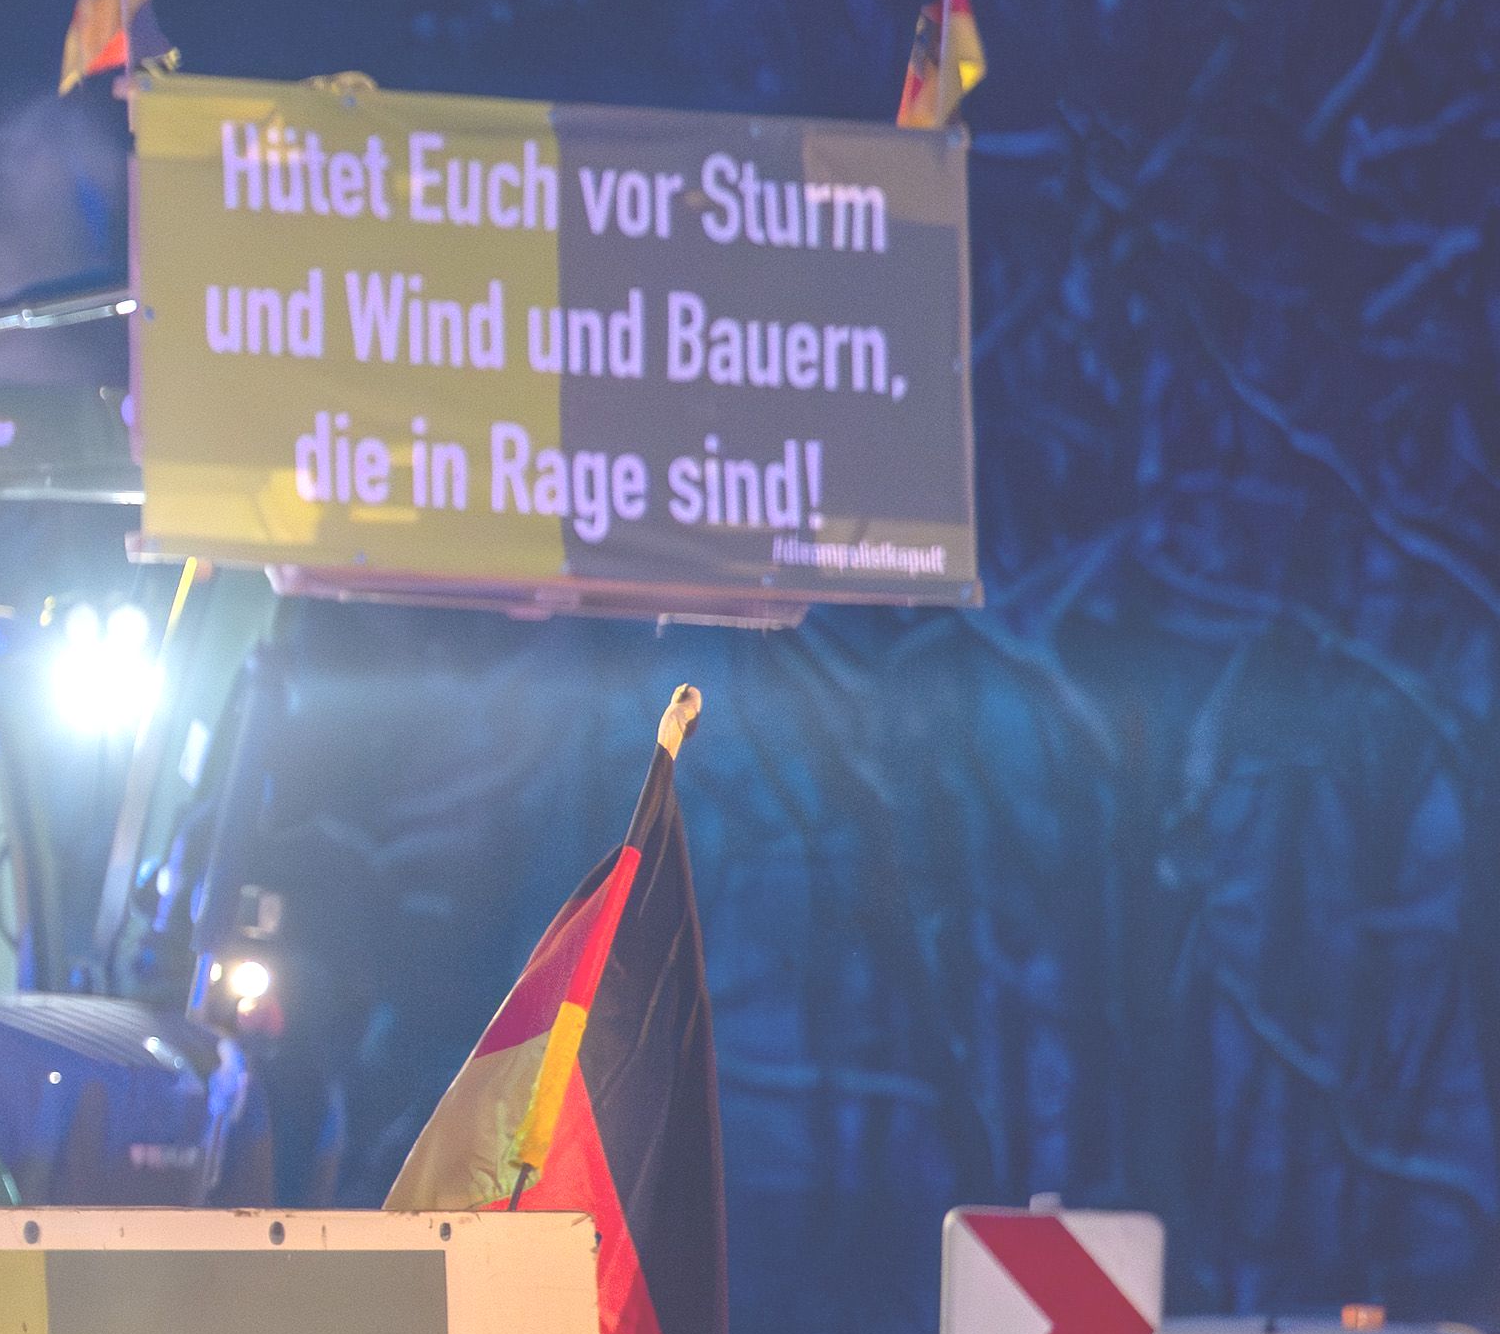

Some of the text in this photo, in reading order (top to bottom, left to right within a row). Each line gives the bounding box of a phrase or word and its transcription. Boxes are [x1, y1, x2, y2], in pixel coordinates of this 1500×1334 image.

[219, 121, 888, 253] Hütet Euch vor Sturm
[205, 269, 908, 400] und Wind und Bauern,
[296, 412, 824, 543] die in Rage sind!
